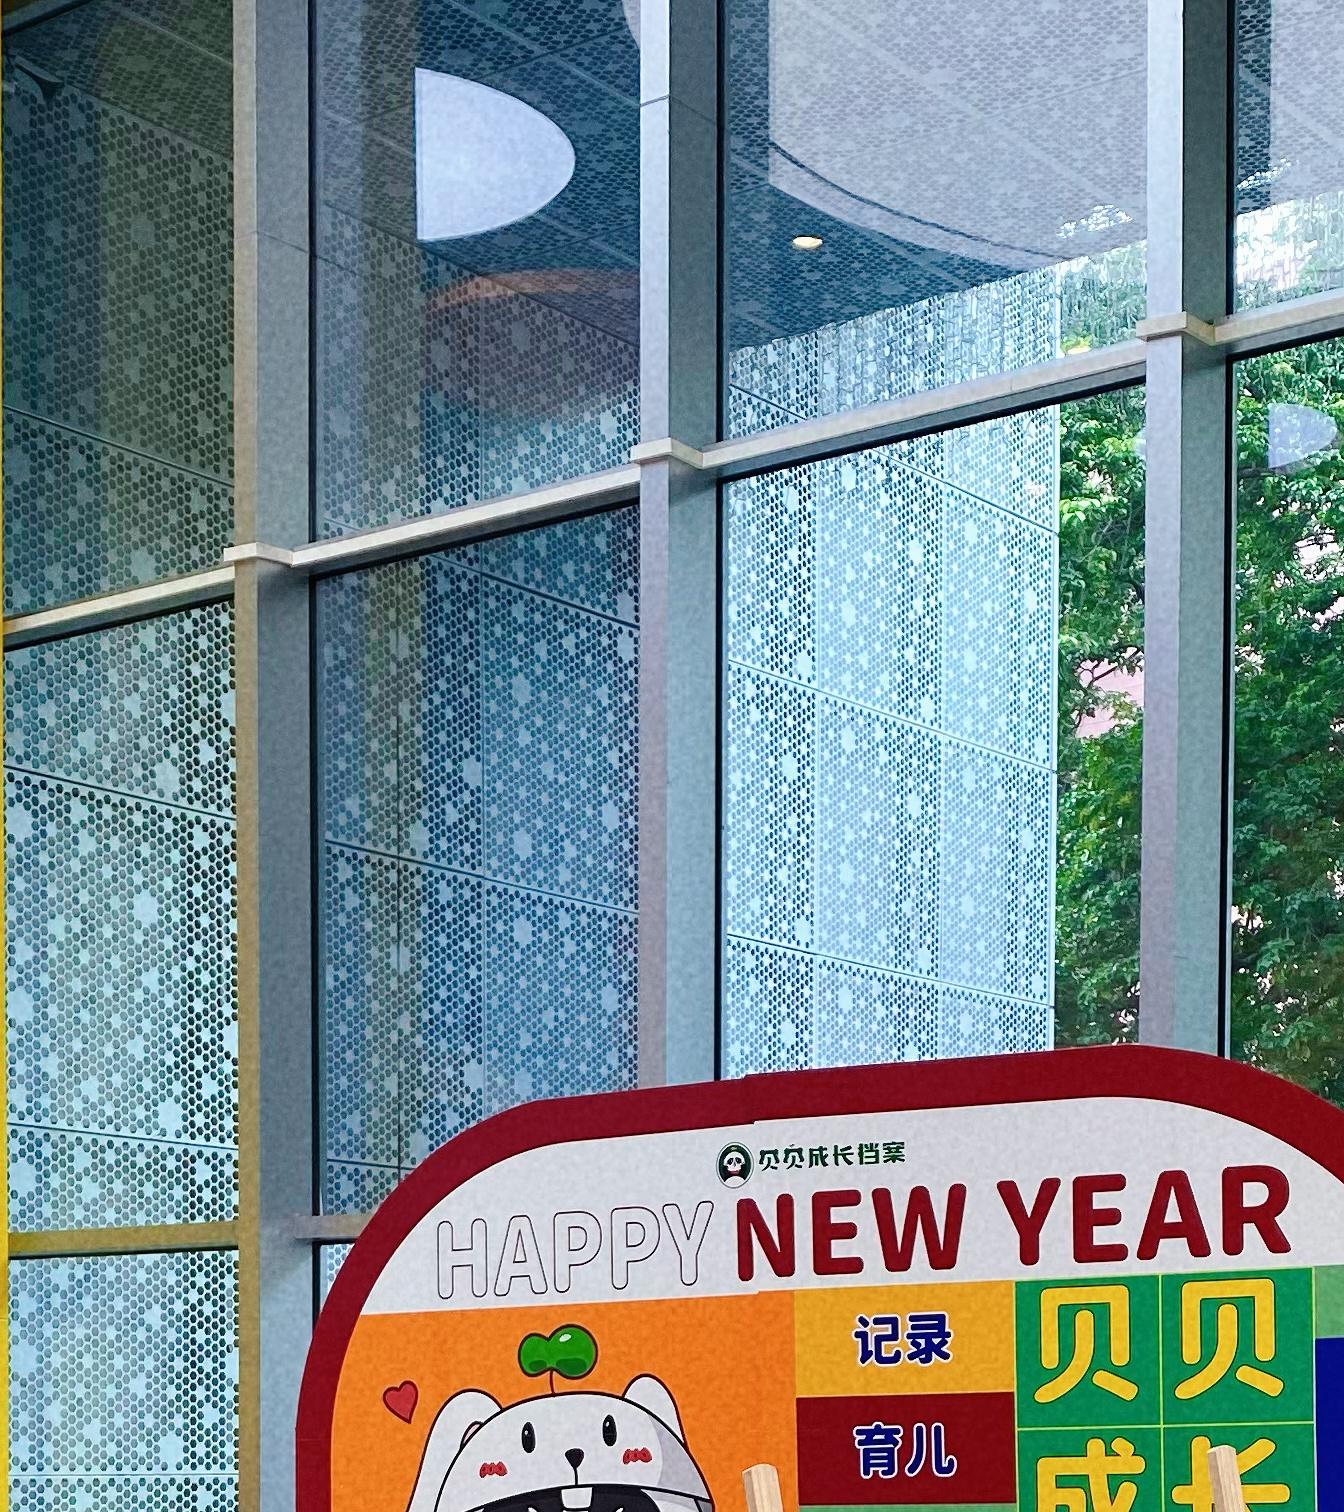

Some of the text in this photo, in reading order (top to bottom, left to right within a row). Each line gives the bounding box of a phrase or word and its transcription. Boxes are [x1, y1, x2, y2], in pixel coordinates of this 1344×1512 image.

[757, 1140, 907, 1175] 贝贝成长档案
[437, 1165, 1293, 1301] HAPPY NEW YEAR
[853, 1313, 953, 1369] 记录
[1032, 1279, 1286, 1404] 贝贝
[854, 1424, 958, 1480] 育儿
